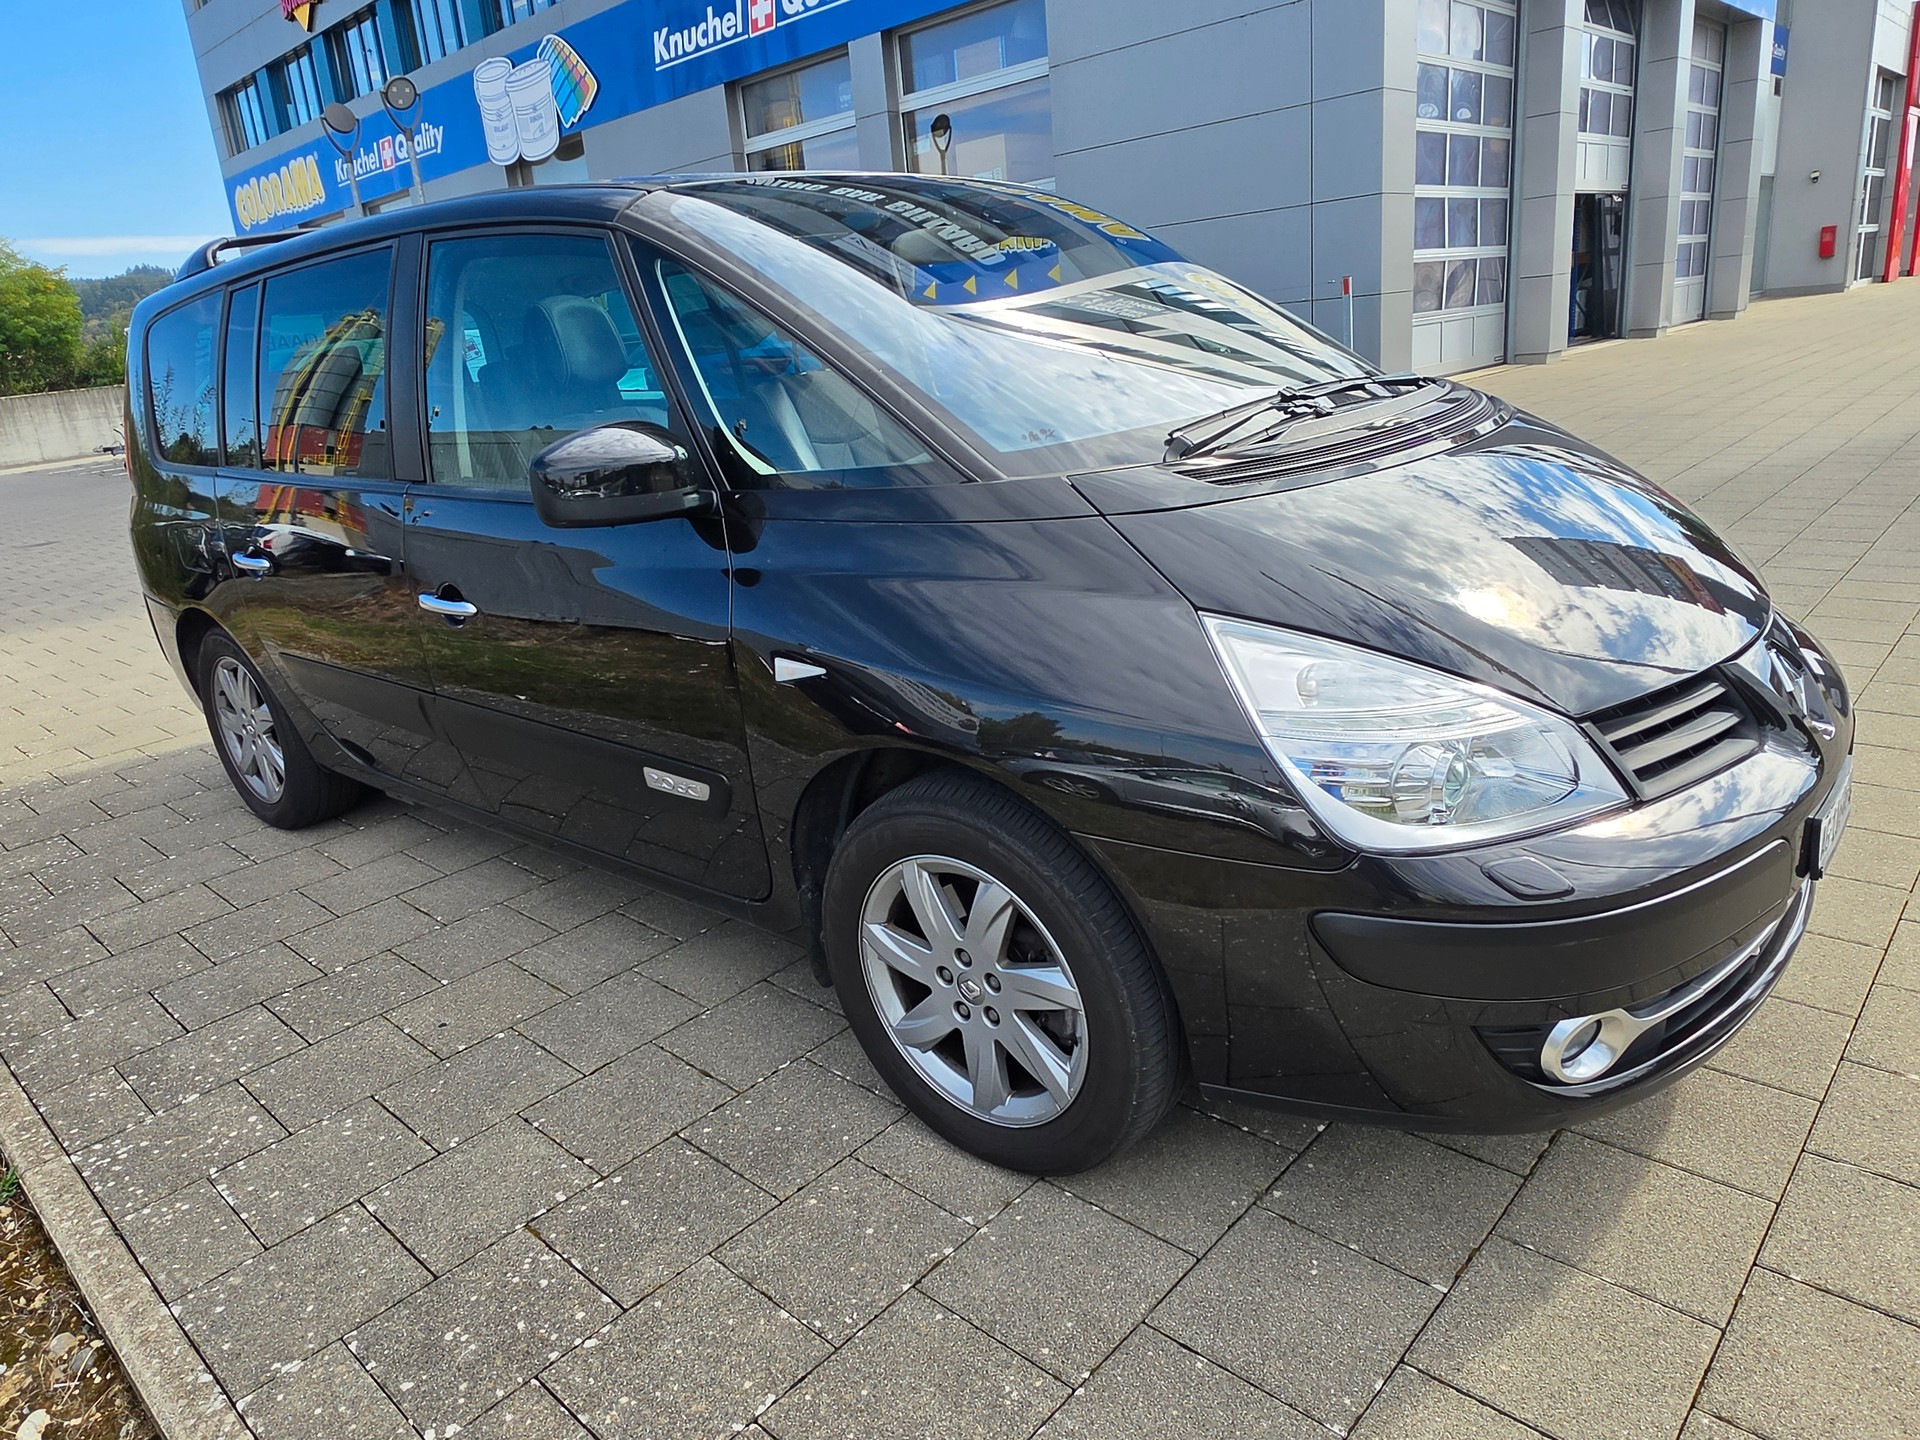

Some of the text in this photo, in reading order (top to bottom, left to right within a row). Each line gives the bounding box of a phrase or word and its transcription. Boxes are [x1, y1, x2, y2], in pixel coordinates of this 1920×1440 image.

[653, 0, 743, 64] Knuchel
[394, 121, 444, 155] Qality
[235, 154, 325, 231] COLORAMA
